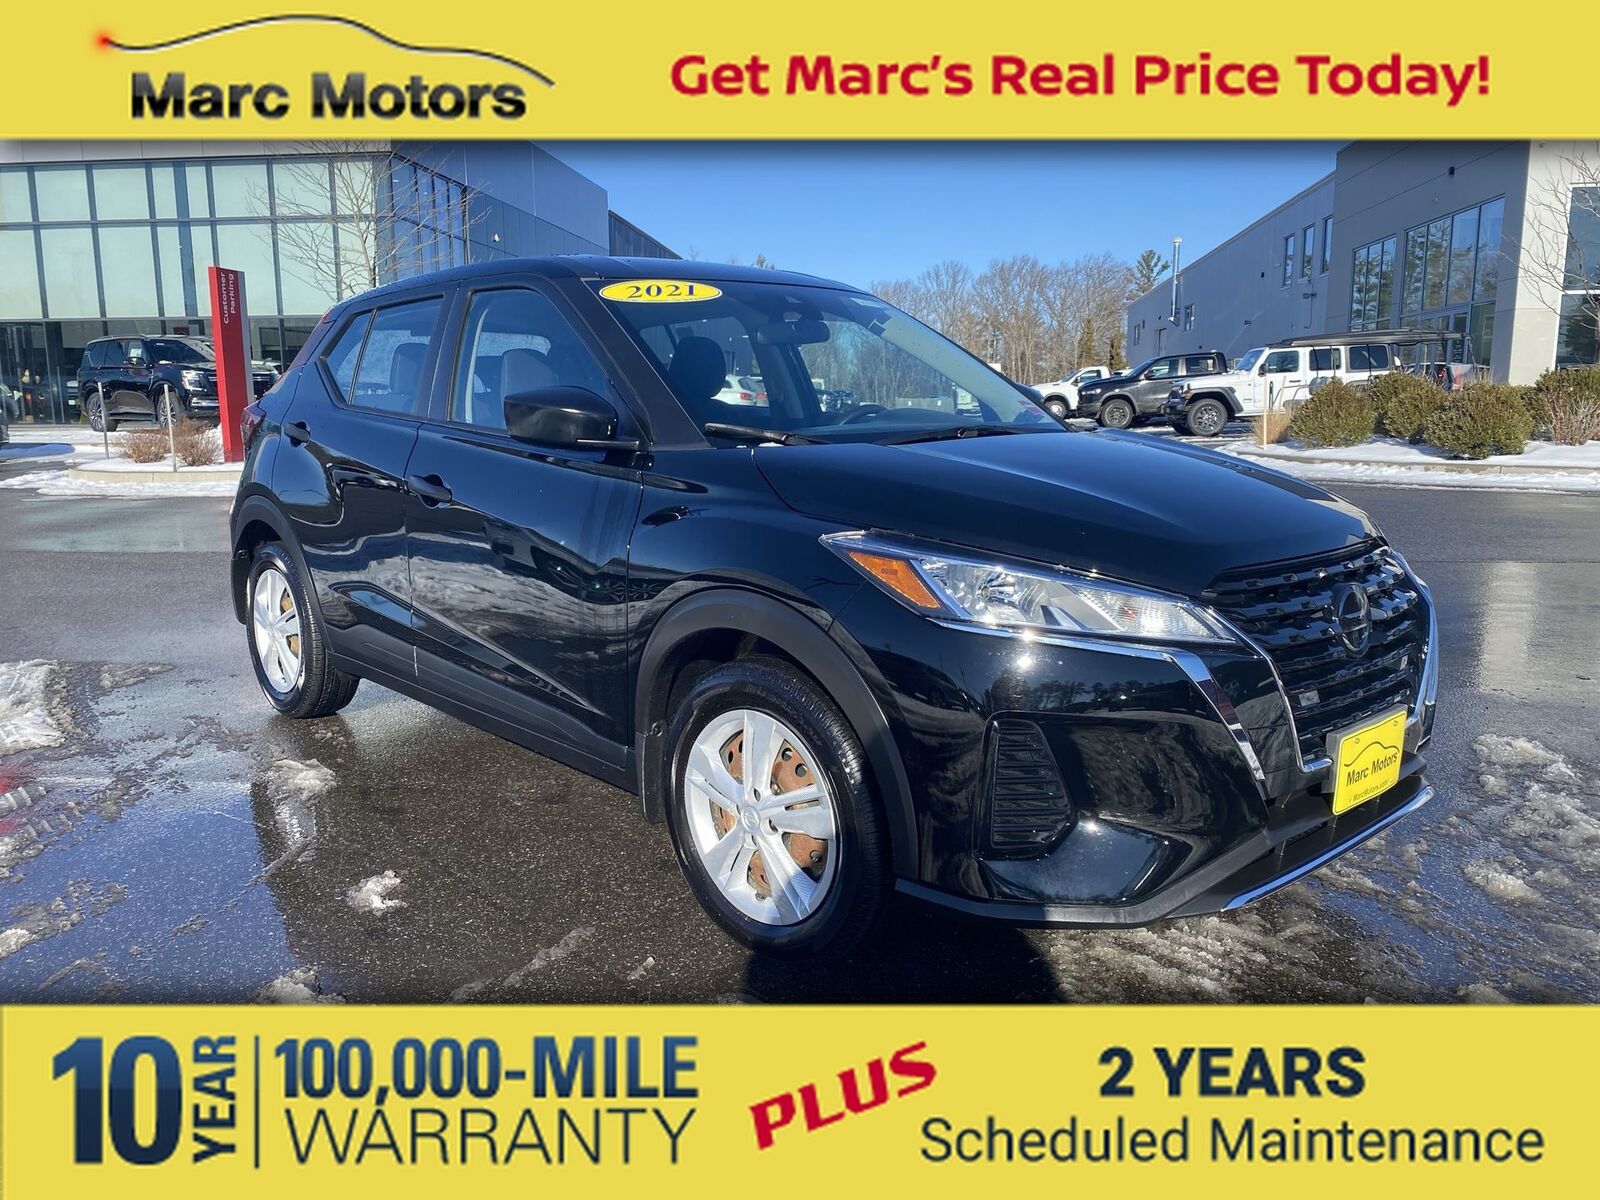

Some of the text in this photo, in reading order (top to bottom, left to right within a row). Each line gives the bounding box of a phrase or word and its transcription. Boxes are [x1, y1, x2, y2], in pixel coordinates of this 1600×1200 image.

[221, 272, 229, 324] Customer
[626, 283, 697, 299] 2021
[1346, 753, 1398, 787] Marc Motors
